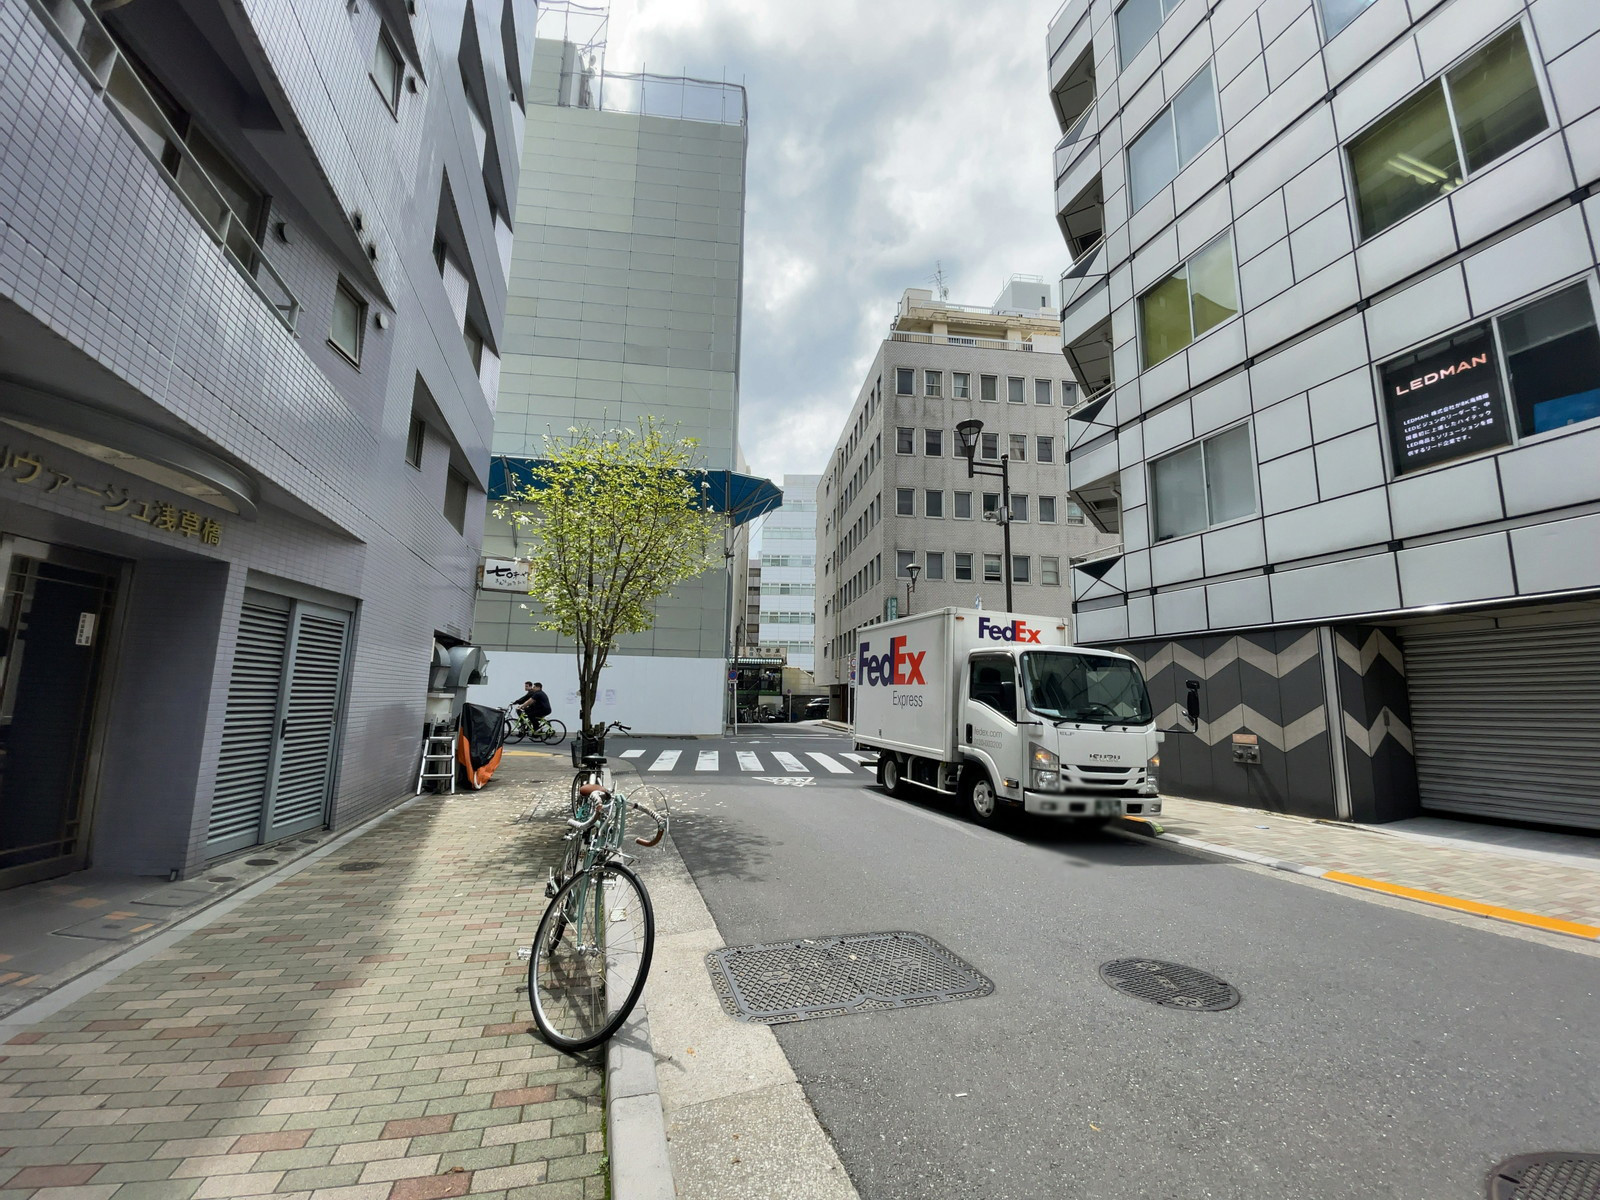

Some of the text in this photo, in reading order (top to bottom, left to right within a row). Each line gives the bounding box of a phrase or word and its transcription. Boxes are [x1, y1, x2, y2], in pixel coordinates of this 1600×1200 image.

[1396, 353, 1486, 396] LEDMAN
[1403, 413, 1429, 426] LEDMAN
[978, 616, 1042, 644] FedEx
[859, 635, 927, 687] FedEx
[892, 690, 923, 709] Express
[1089, 753, 1121, 762] ISUZU
